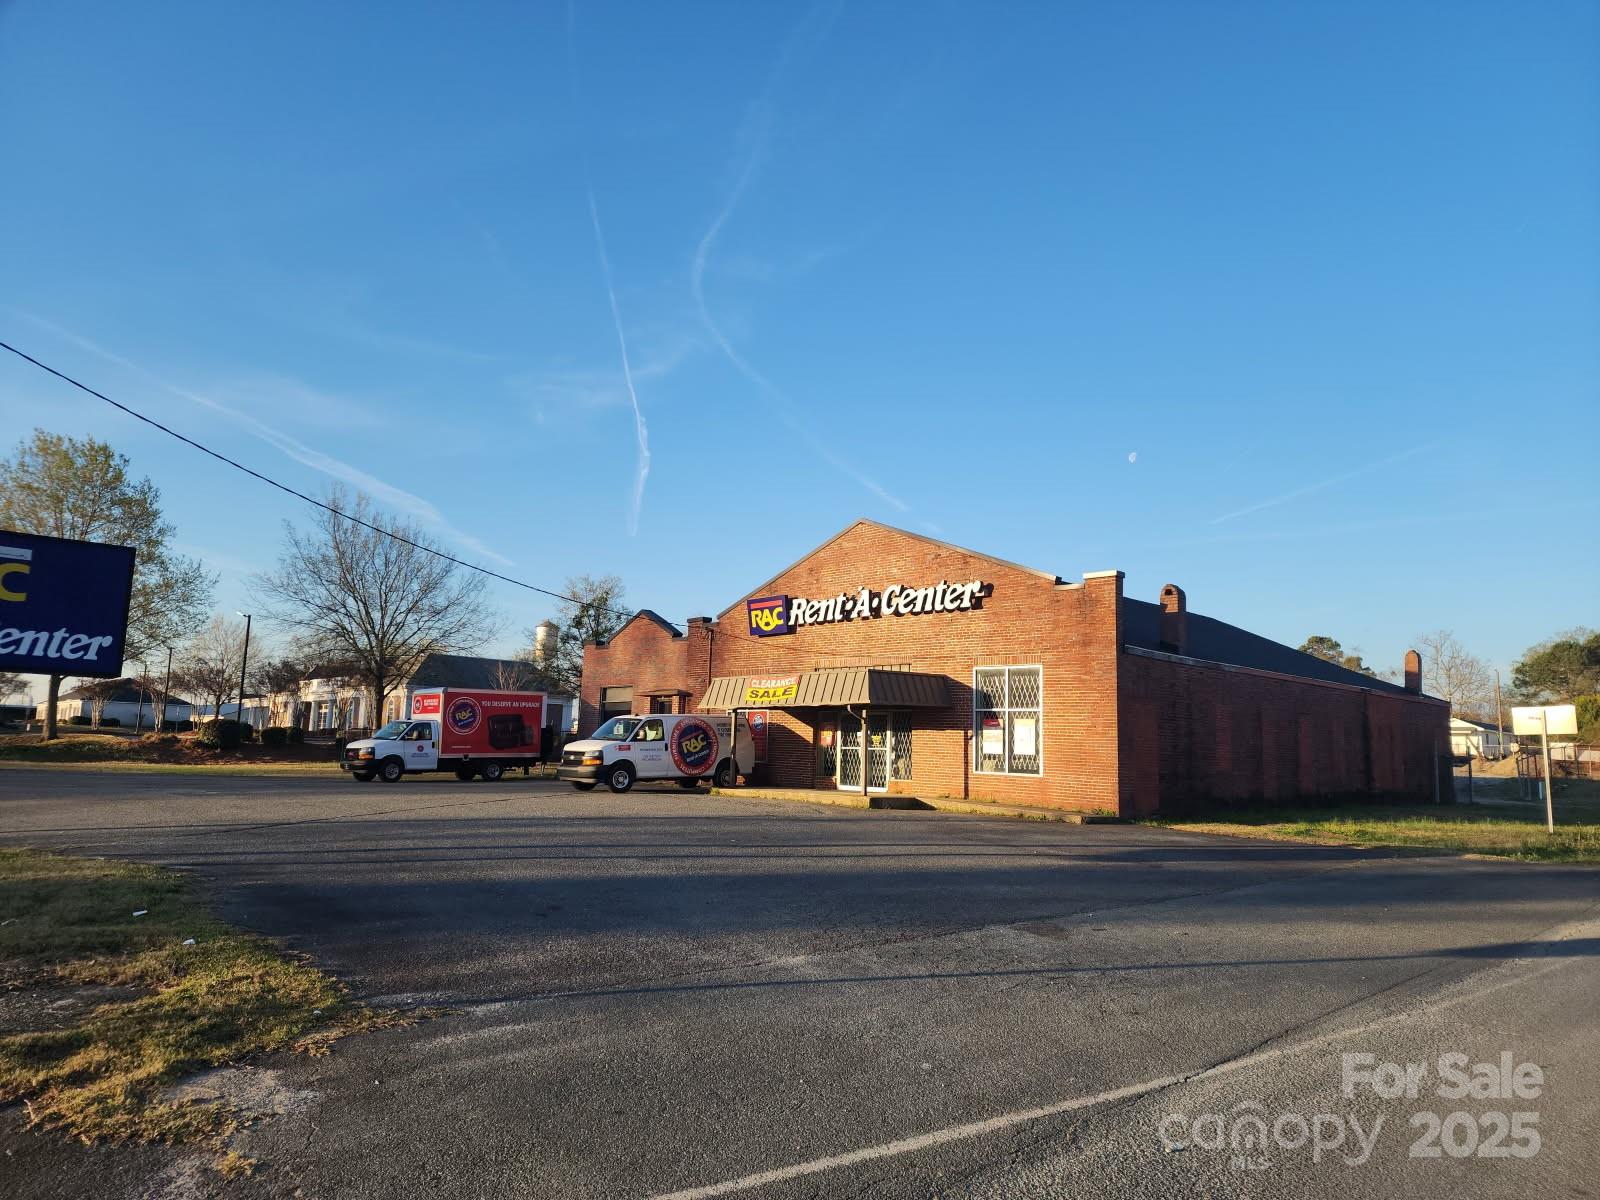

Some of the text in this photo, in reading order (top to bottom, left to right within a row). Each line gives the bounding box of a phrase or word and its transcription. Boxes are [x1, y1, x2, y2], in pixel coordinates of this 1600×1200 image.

[751, 606, 785, 631] RAC
[0, 626, 113, 661] enter
[749, 686, 796, 699] SALE
[455, 708, 473, 721] RAC
[681, 733, 707, 753] RAC
